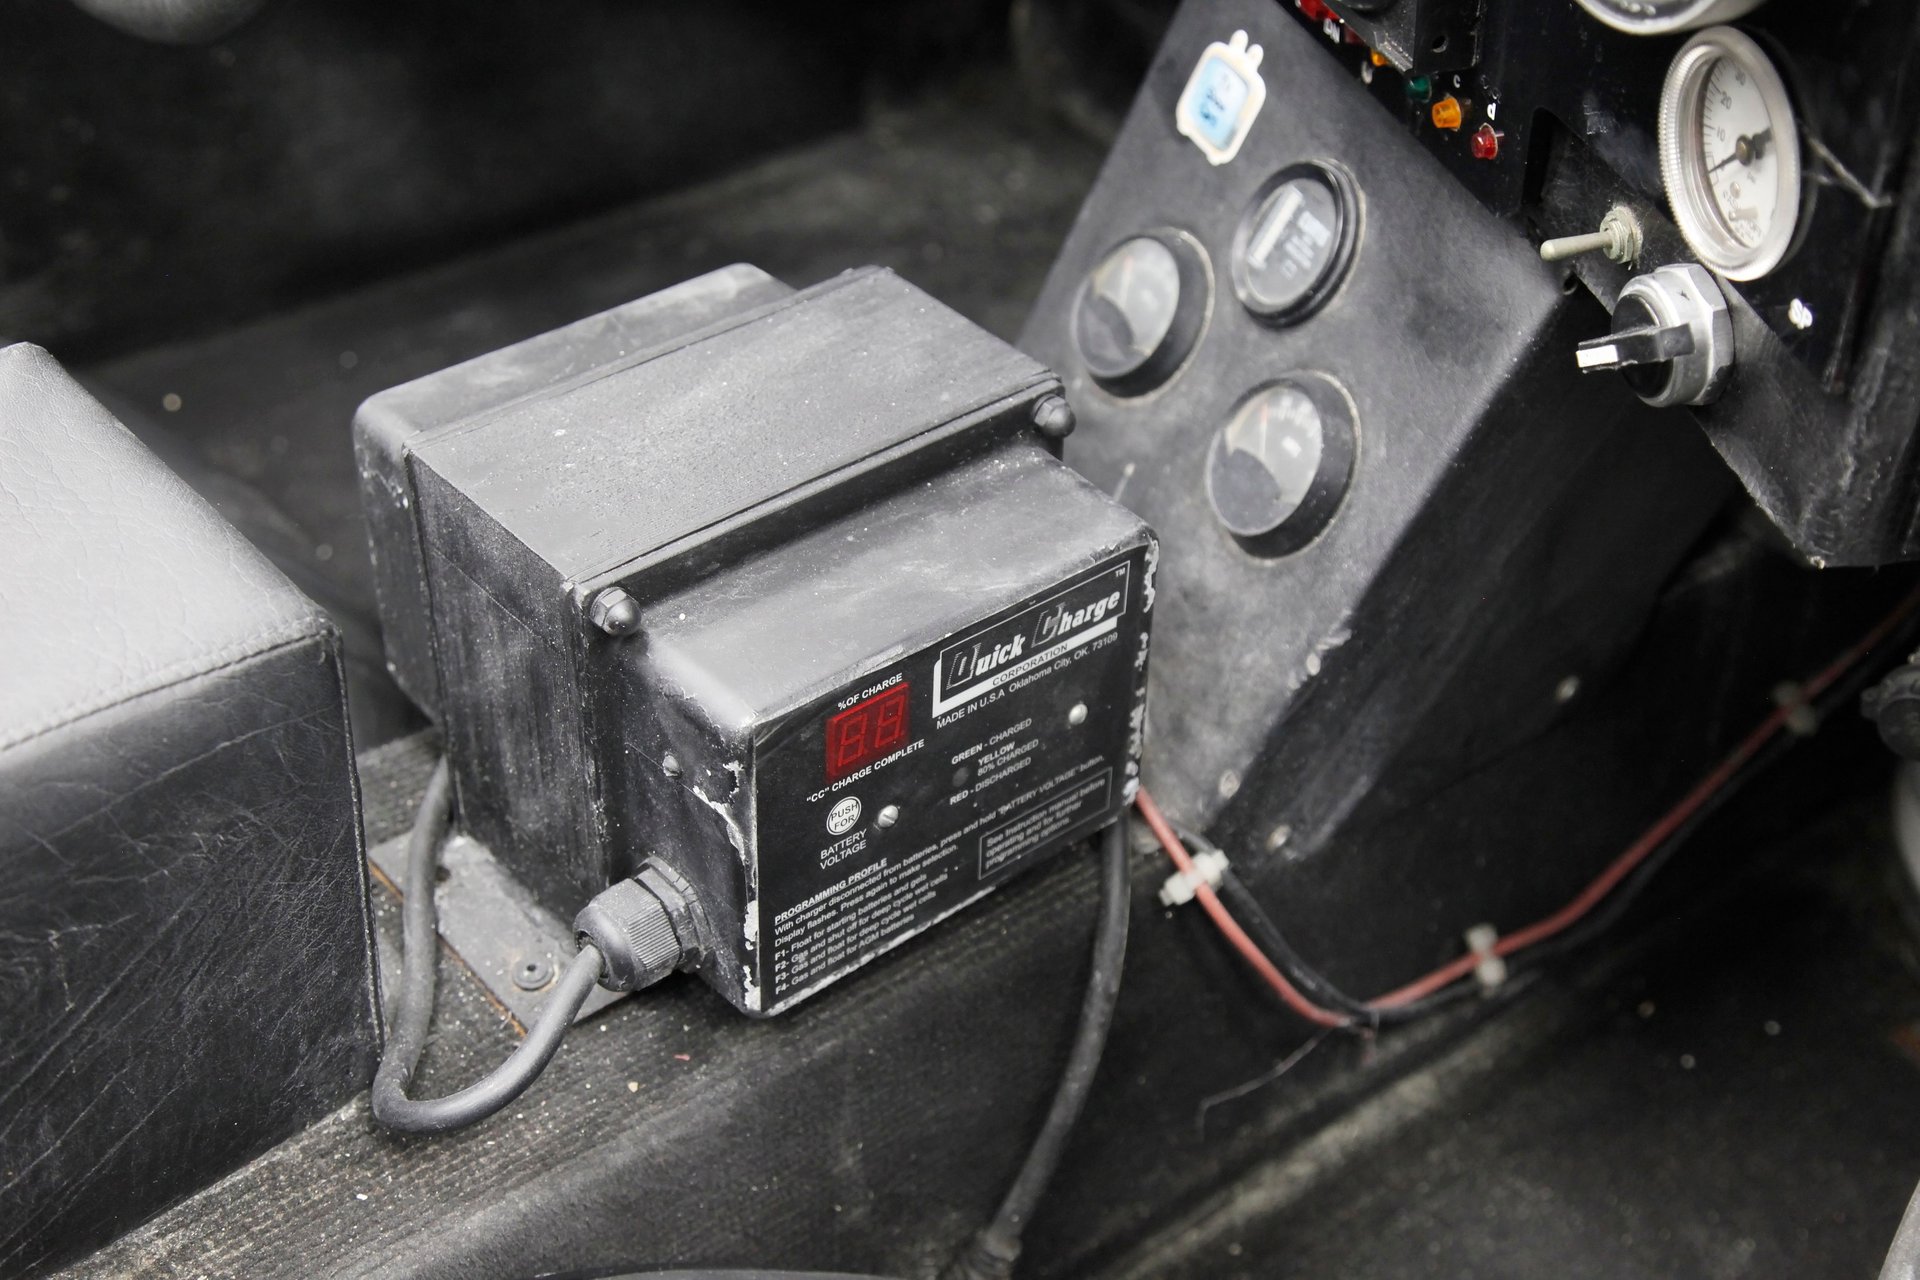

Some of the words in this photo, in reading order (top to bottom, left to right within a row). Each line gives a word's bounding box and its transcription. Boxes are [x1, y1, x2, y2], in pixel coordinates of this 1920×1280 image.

[946, 634, 1025, 690] Quick
[1031, 591, 1120, 648] Charge
[992, 643, 1068, 686] CORPORATION
[862, 673, 903, 699] CHARGE
[937, 709, 965, 729] MADE
[967, 702, 977, 714] IN
[1009, 667, 1051, 692] Oklahoma
[1054, 657, 1072, 671] City,
[1074, 648, 1090, 660] OK.
[1092, 632, 1118, 651] 73109
[951, 743, 983, 764] GREEN
[989, 718, 1032, 745] CHARGED
[978, 742, 1015, 766] YELLOW
[978, 762, 995, 776] 80%
[997, 739, 1039, 767] CHARGED
[832, 765, 872, 792] CHARGE
[874, 739, 925, 770] COMPLETE
[950, 790, 968, 805] RED
[975, 757, 1032, 792] DISCHARGED
[831, 803, 858, 821] PUSH
[834, 814, 855, 830] FOR
[820, 828, 867, 859] BATTERY
[820, 839, 866, 870] VOLTAGE
[985, 833, 1039, 870] programming
[774, 880, 847, 925] PROGRAMMING
[848, 858, 888, 884] PROFILE
[775, 922, 794, 936] With
[795, 902, 827, 924] charger
[828, 872, 882, 906] disconnected
[883, 863, 901, 877] from
[903, 844, 939, 867] batteries,
[940, 830, 962, 848] press
[964, 821, 978, 834] and
[979, 809, 996, 825] hold
[775, 926, 806, 947] Display
[807, 909, 838, 929] flashes.
[841, 895, 864, 912] Press
[866, 882, 888, 899] again
[889, 876, 898, 886] to
[899, 864, 920, 880] make
[791, 936, 812, 952] Float
[813, 929, 825, 940] for
[826, 912, 856, 933] starting
[858, 893, 892, 915] batteries
[894, 882, 909, 896] and
[910, 874, 927, 889] gels
[791, 950, 809, 963] Gas
[810, 939, 826, 953] and
[827, 929, 845, 943] shut
[846, 921, 858, 933] off
[859, 916, 870, 926] for
[871, 904, 891, 920] deep
[893, 892, 913, 908] cycle
[915, 882, 929, 895] wet
[930, 873, 948, 887] cells
[791, 962, 809, 974] Gas
[810, 950, 826, 964] and
[827, 940, 845, 955] float
[846, 933, 858, 944] for
[859, 922, 880, 937] deep
[881, 910, 901, 926] cycle
[903, 900, 917, 913] wet
[918, 891, 936, 905] cells
[791, 972, 809, 985] Gas
[810, 961, 826, 975] and
[827, 951, 845, 966] float
[846, 945, 858, 956] for
[859, 931, 880, 949] AGM
[881, 914, 915, 936] batteries
